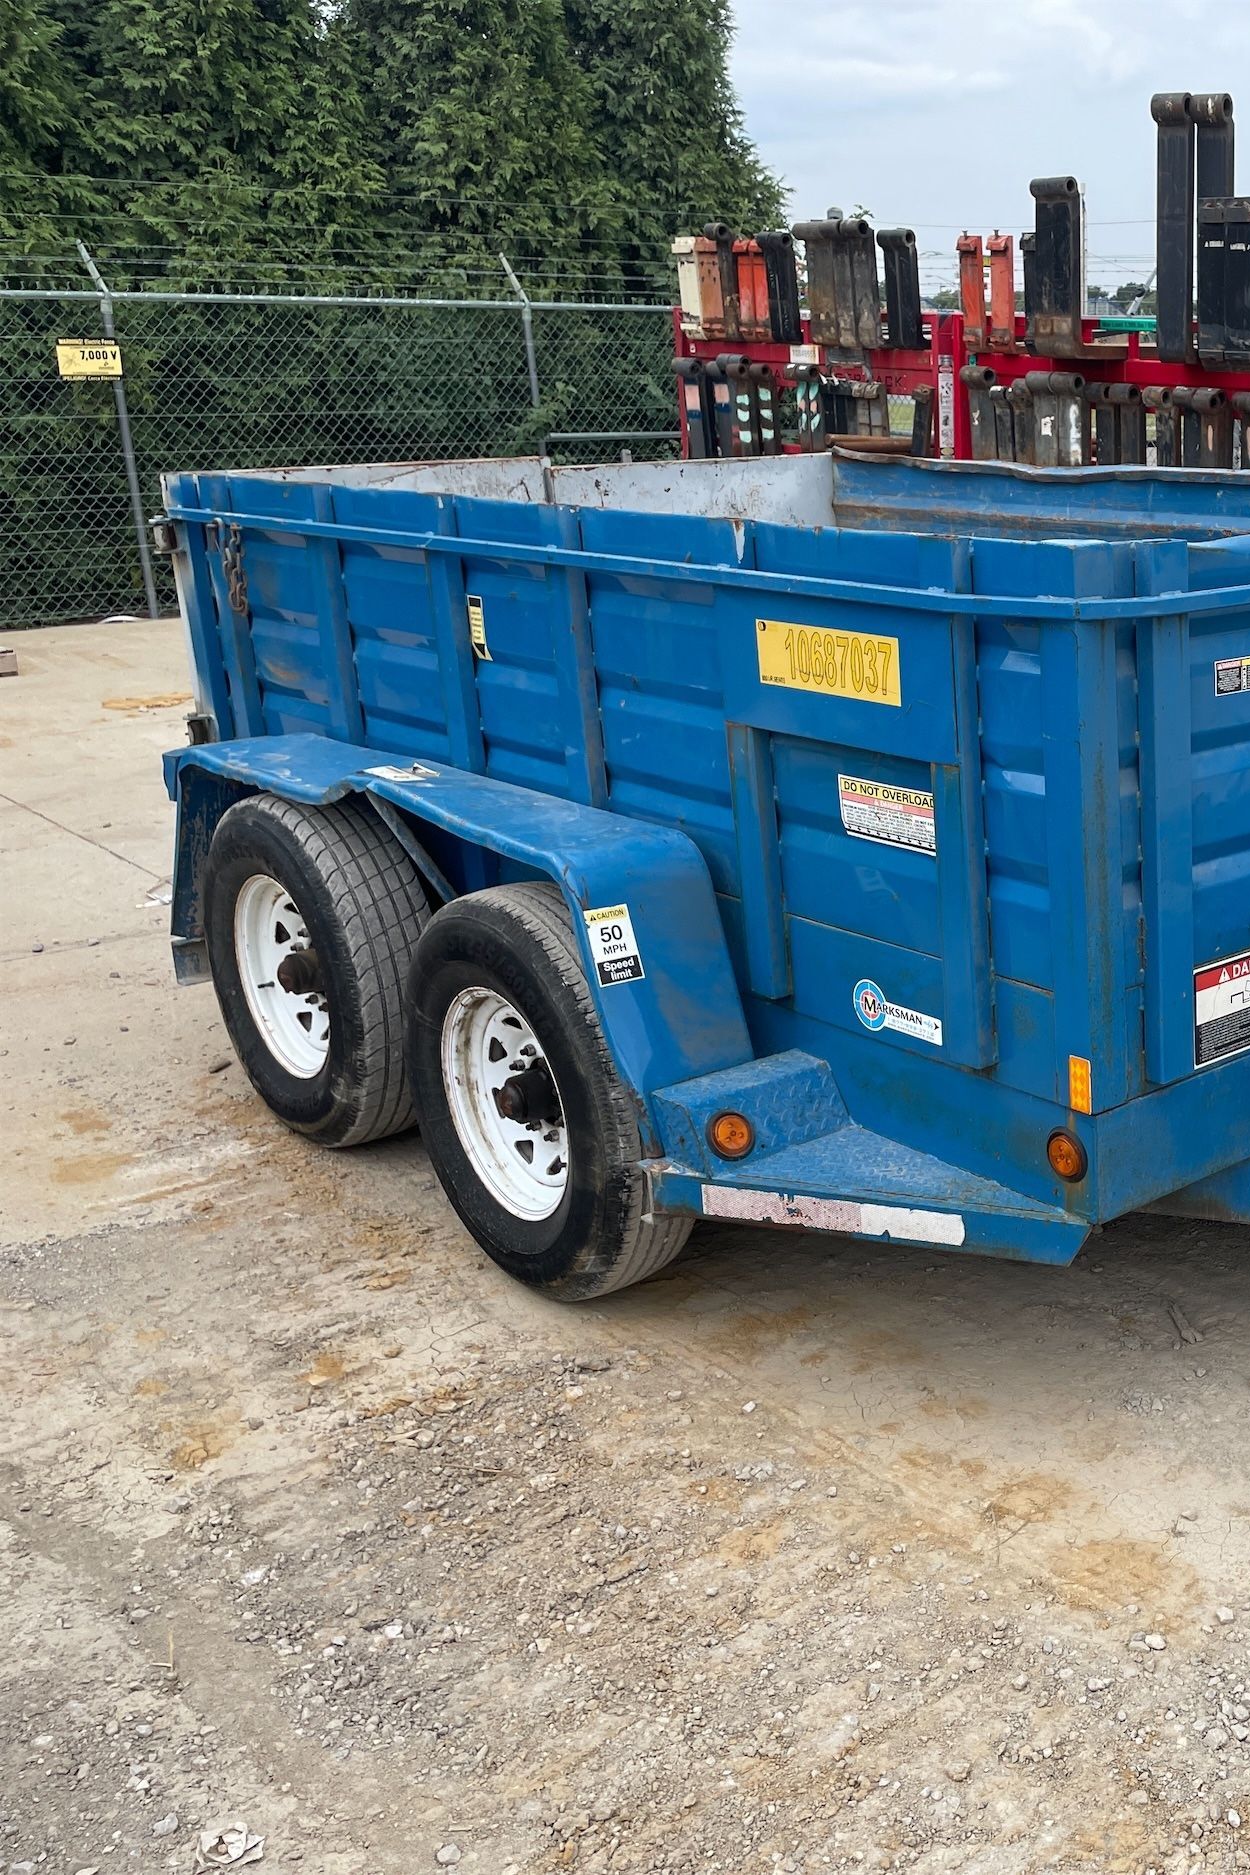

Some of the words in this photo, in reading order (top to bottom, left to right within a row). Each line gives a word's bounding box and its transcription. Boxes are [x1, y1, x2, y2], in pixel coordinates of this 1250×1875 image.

[80, 350, 108, 361] 7,000
[110, 350, 117, 360] V
[785, 628, 892, 696] 10687037
[843, 780, 857, 792] DO
[860, 784, 880, 797] NOT
[882, 789, 934, 808] OVERLOAD
[597, 908, 624, 920] CAUTION
[600, 924, 623, 943] 50
[603, 942, 627, 955] MPH
[603, 957, 634, 972] Speed
[610, 968, 633, 981] limit
[864, 996, 923, 1026] MARKSMAN
